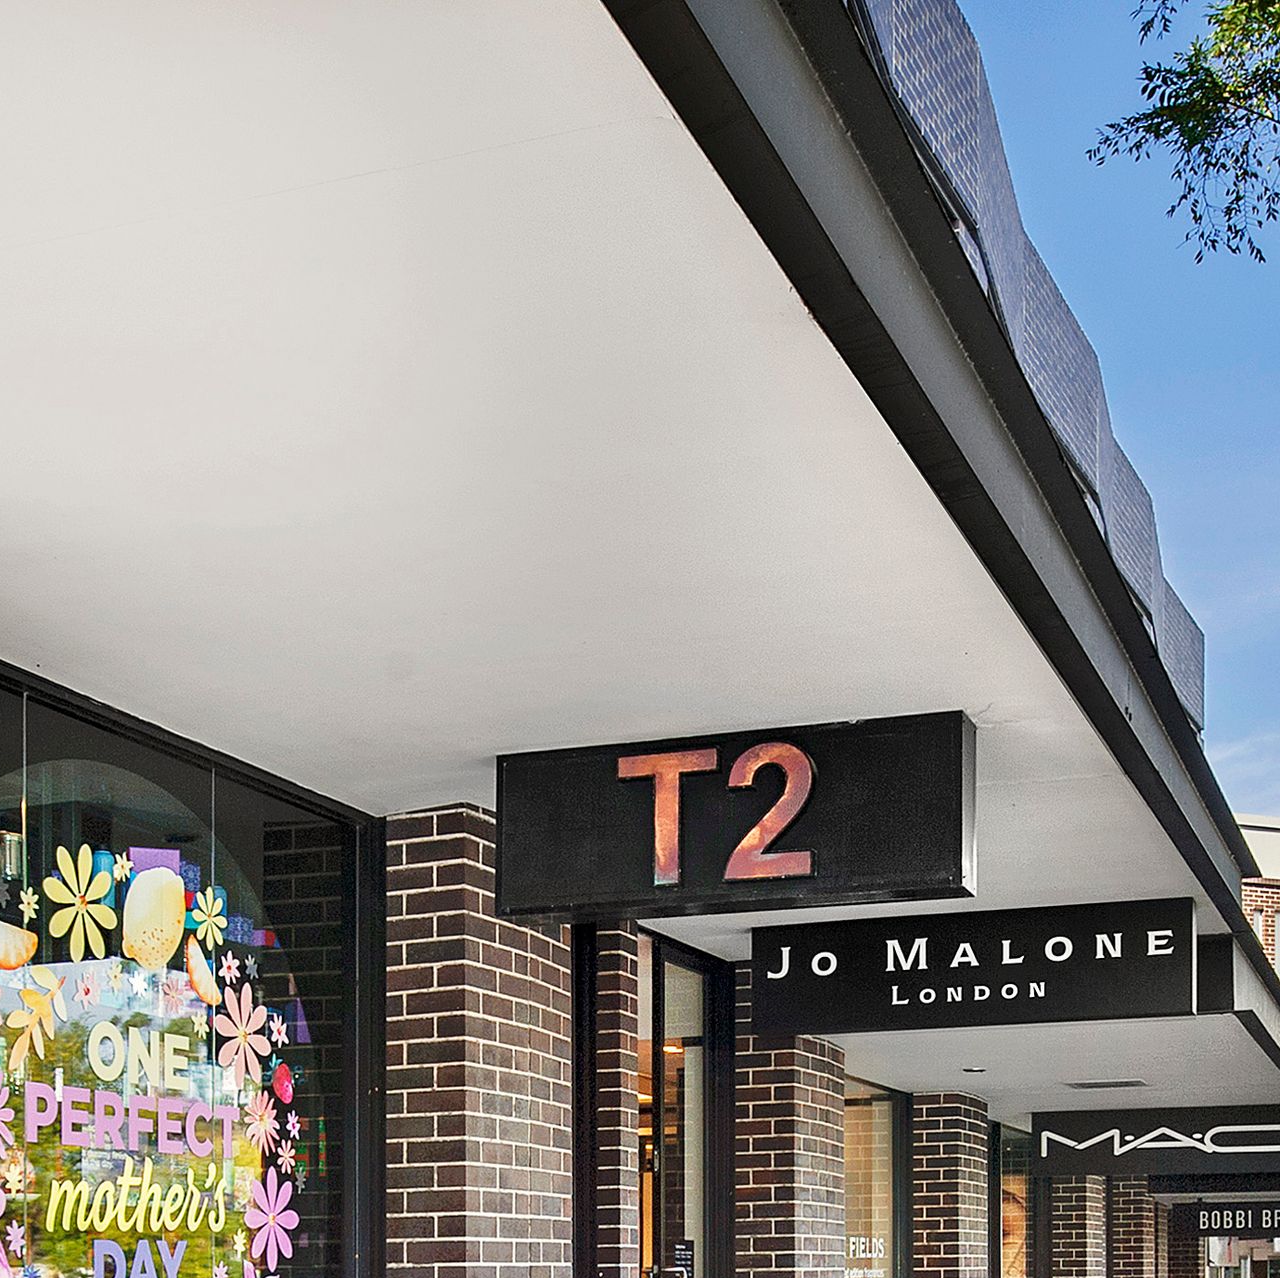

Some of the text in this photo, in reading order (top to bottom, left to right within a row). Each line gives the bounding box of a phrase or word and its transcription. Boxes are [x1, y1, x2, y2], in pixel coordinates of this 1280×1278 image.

[618, 742, 812, 886] T2
[88, 1021, 190, 1090] ONE
[24, 1081, 241, 1158] PERFECT
[45, 1157, 228, 1233] mother's
[1199, 1210, 1253, 1230] BOBBI
[850, 1236, 885, 1258] FIELDS
